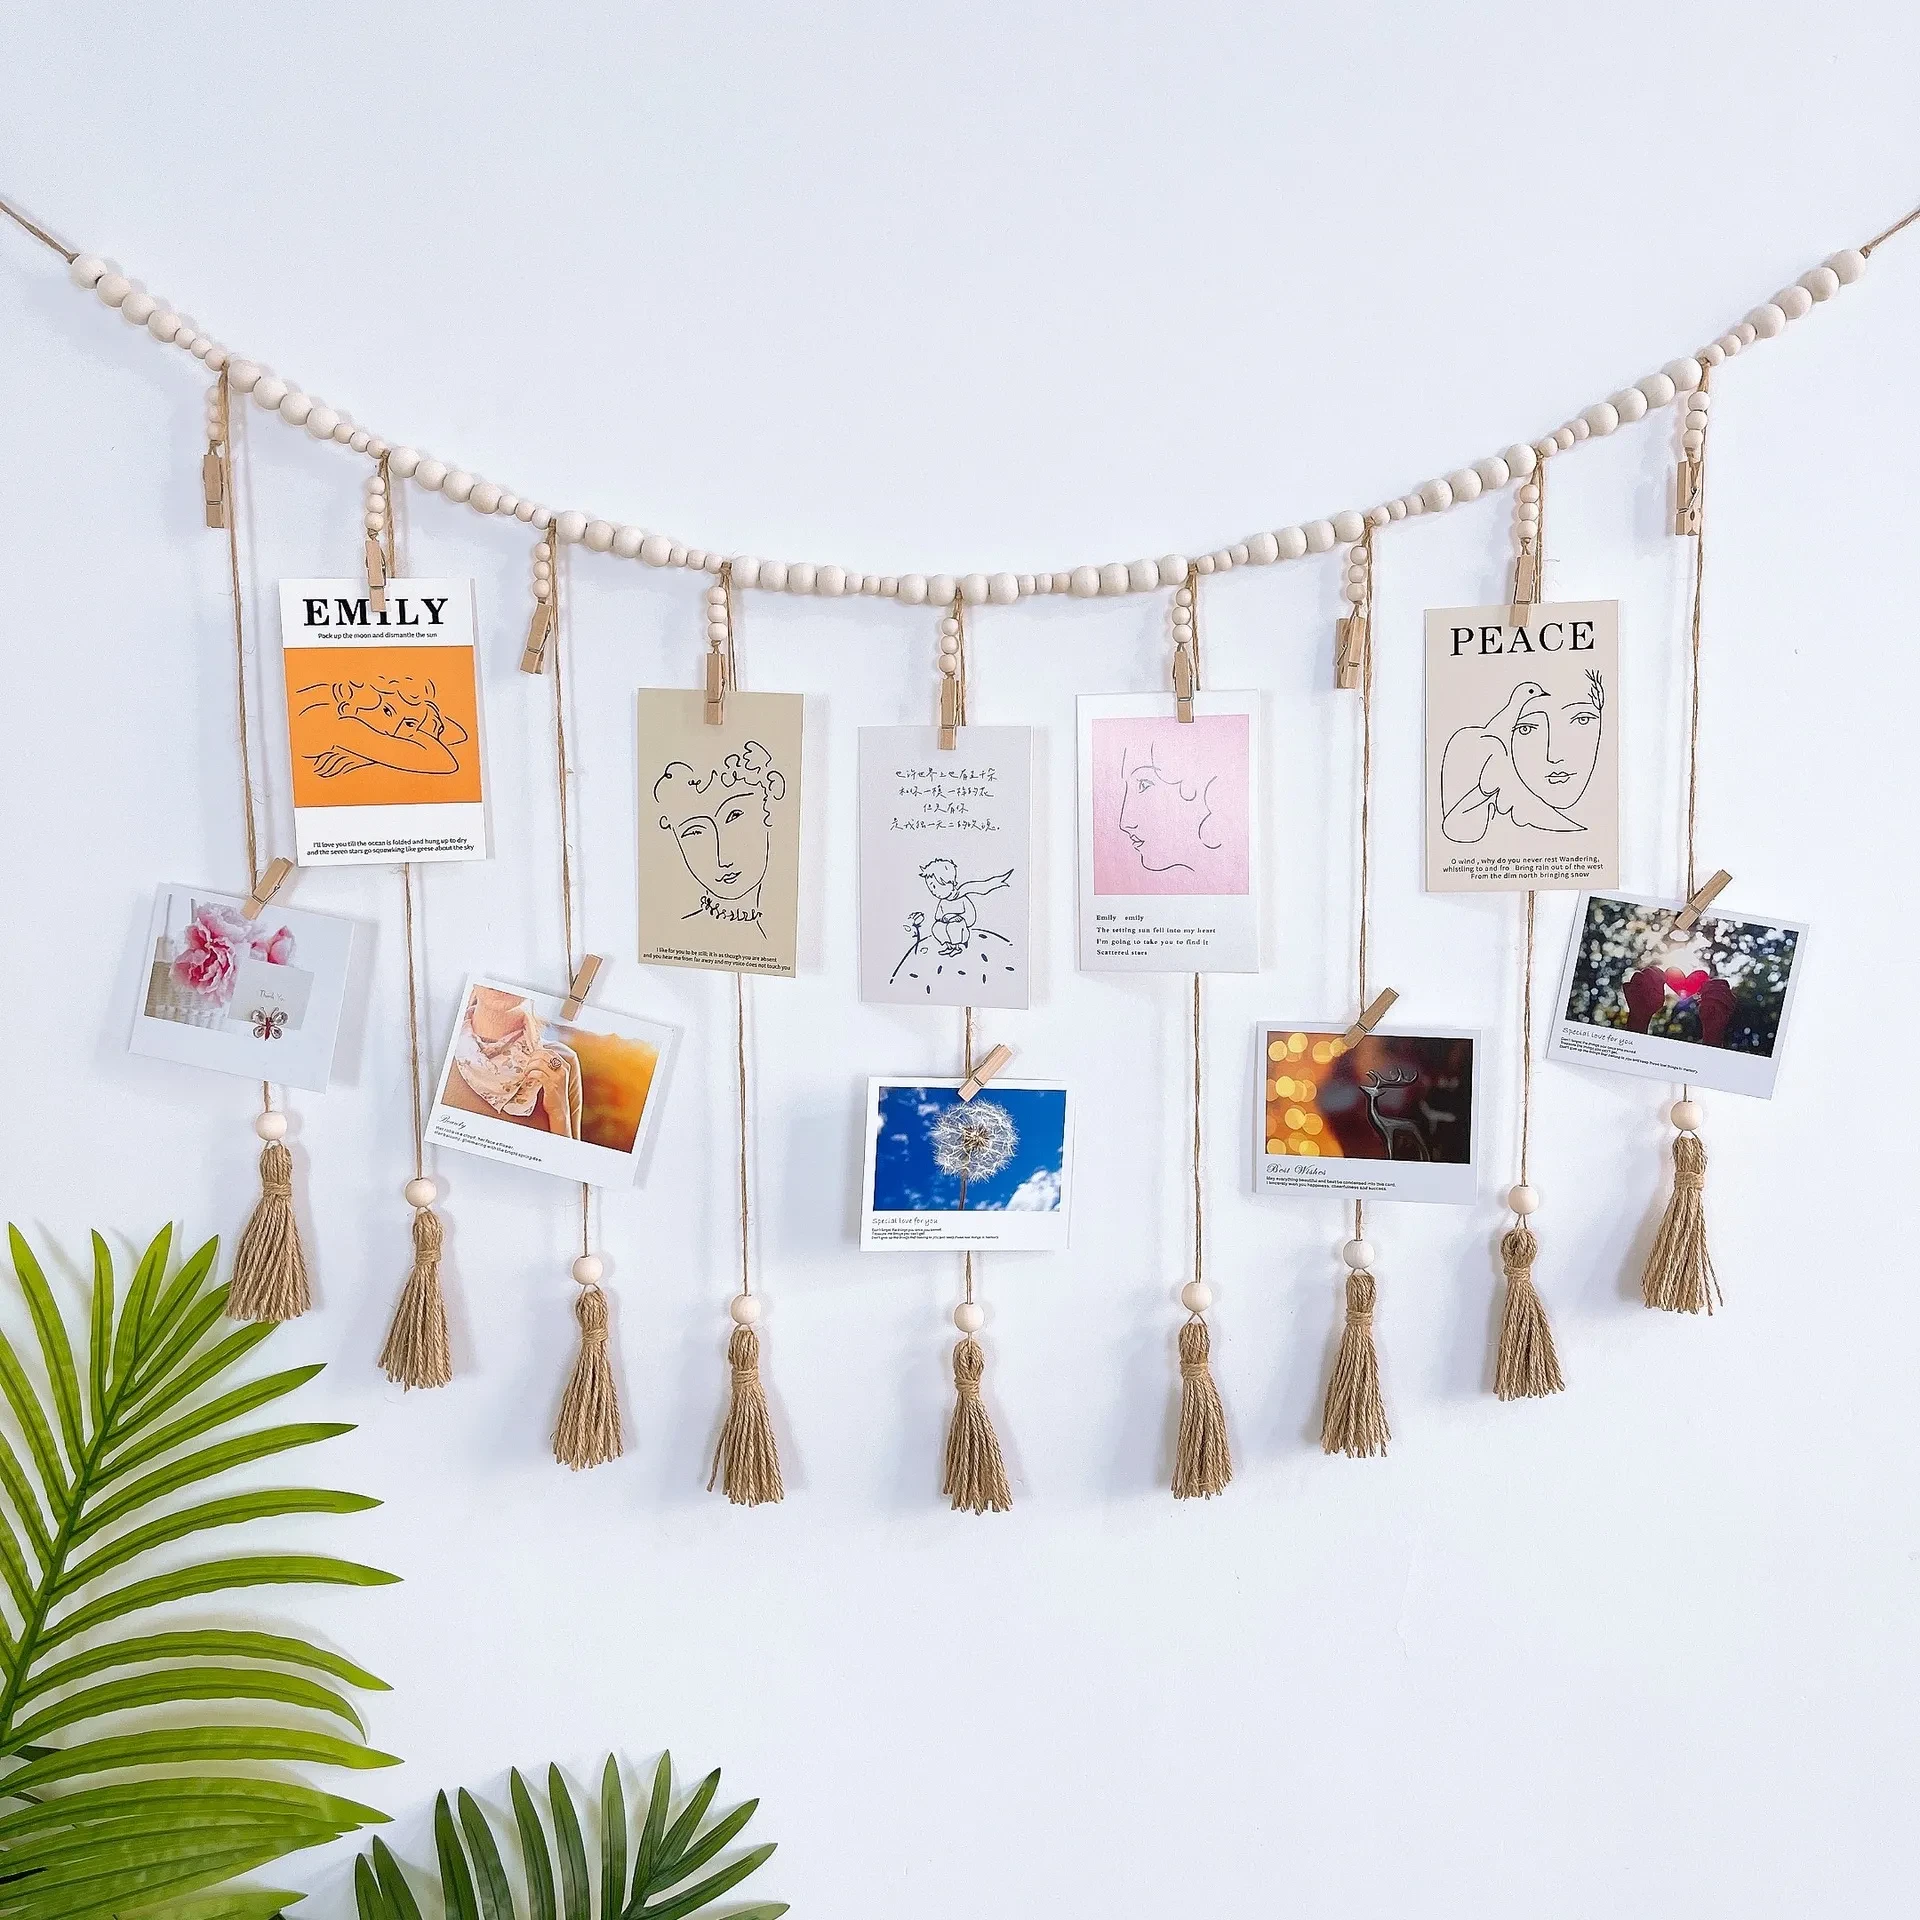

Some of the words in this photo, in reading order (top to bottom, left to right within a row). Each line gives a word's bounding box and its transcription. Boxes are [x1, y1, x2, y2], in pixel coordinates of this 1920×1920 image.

[1450, 621, 1594, 656] PEACE
[1562, 1027, 1590, 1038] Special
[1591, 1032, 1606, 1040] love
[1606, 1034, 1618, 1043] for
[1619, 1038, 1634, 1046] you
[1266, 1163, 1291, 1174] Best
[1294, 1164, 1327, 1176] Wishes
[872, 1217, 897, 1226] Special
[914, 1217, 923, 1225] for
